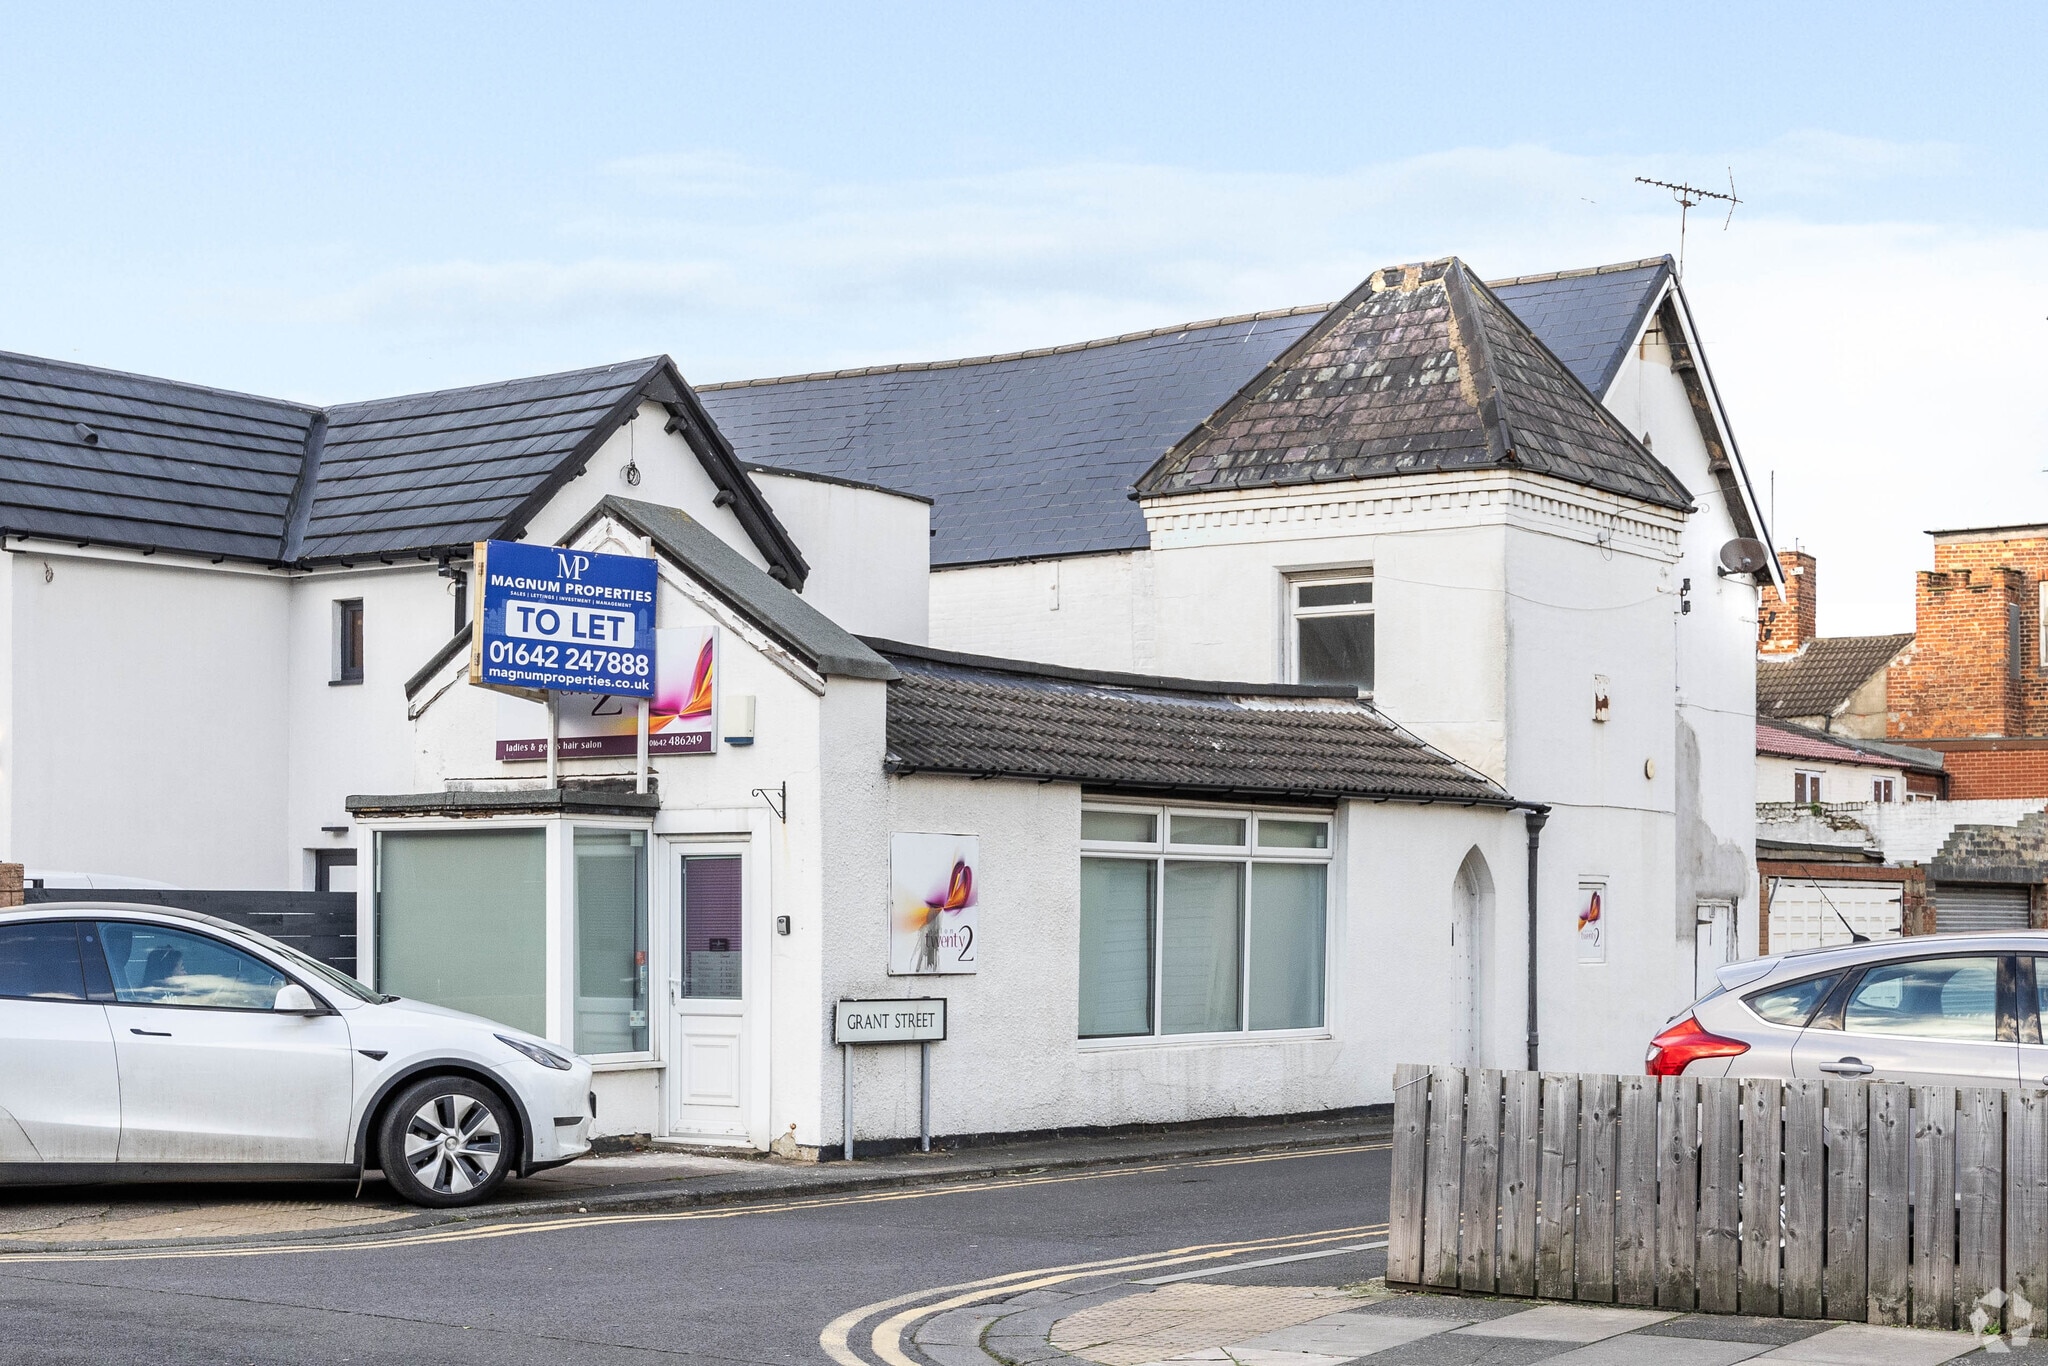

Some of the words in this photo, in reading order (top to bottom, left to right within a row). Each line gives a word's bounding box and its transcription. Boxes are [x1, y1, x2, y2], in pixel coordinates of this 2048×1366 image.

[556, 553, 590, 581] MP
[491, 574, 560, 592] MAGNUM
[565, 583, 652, 602] PROPERTIES
[510, 590, 526, 598] SALES
[559, 596, 591, 604] INVESTMENT
[595, 600, 632, 608] MANAGEMENT
[517, 606, 560, 635] TO
[572, 612, 625, 642] LET
[489, 640, 559, 668] 01642
[565, 648, 649, 676] 247888
[489, 668, 649, 690] magnumproperties.co.uk
[505, 743, 528, 752] ladies
[530, 742, 537, 751] &
[538, 743, 561, 753] ges
[563, 741, 579, 749] hair
[581, 740, 602, 749] salon
[649, 739, 667, 747] 01642
[668, 734, 703, 746] 486249
[957, 925, 974, 961] 2
[1593, 927, 1601, 947] 2
[847, 1013, 890, 1030] GRANT
[895, 1012, 935, 1029] STREET
